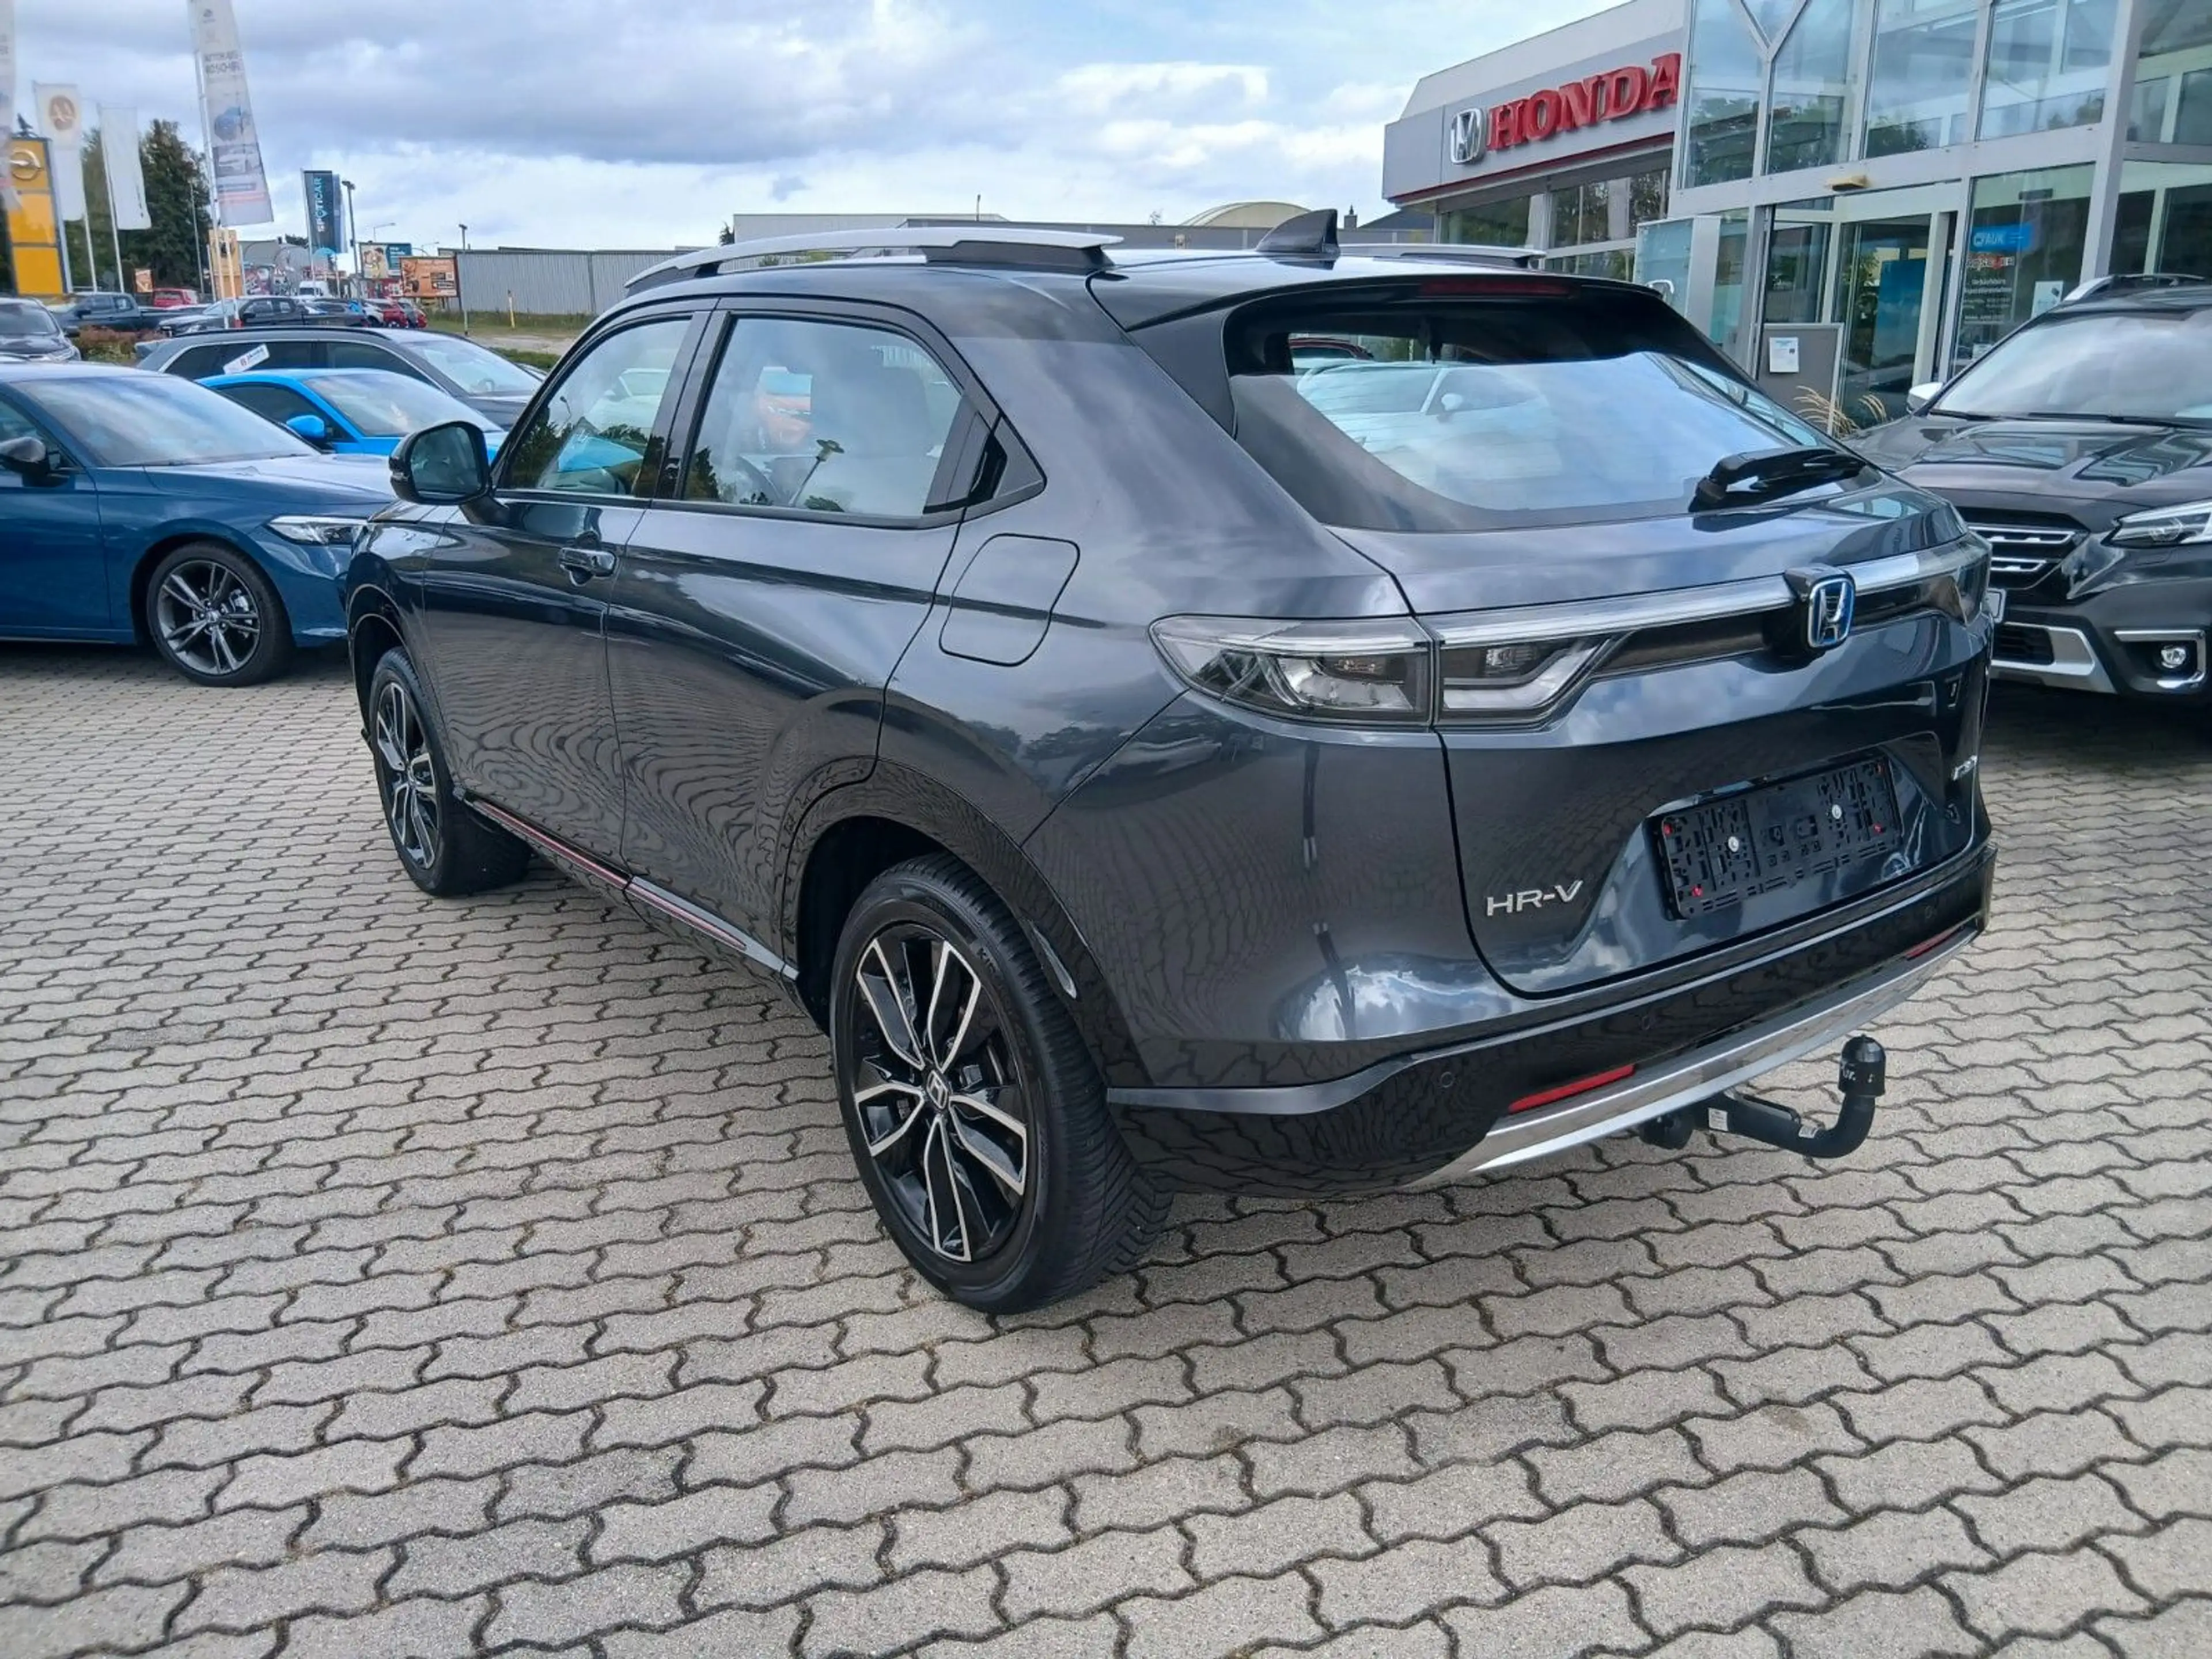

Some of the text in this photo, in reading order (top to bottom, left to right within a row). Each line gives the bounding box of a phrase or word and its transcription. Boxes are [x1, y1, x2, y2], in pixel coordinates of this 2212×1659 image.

[1485, 52, 1681, 151] HONDA
[313, 177, 328, 232] SPOTICAR
[1486, 880, 1584, 916] HR-V
